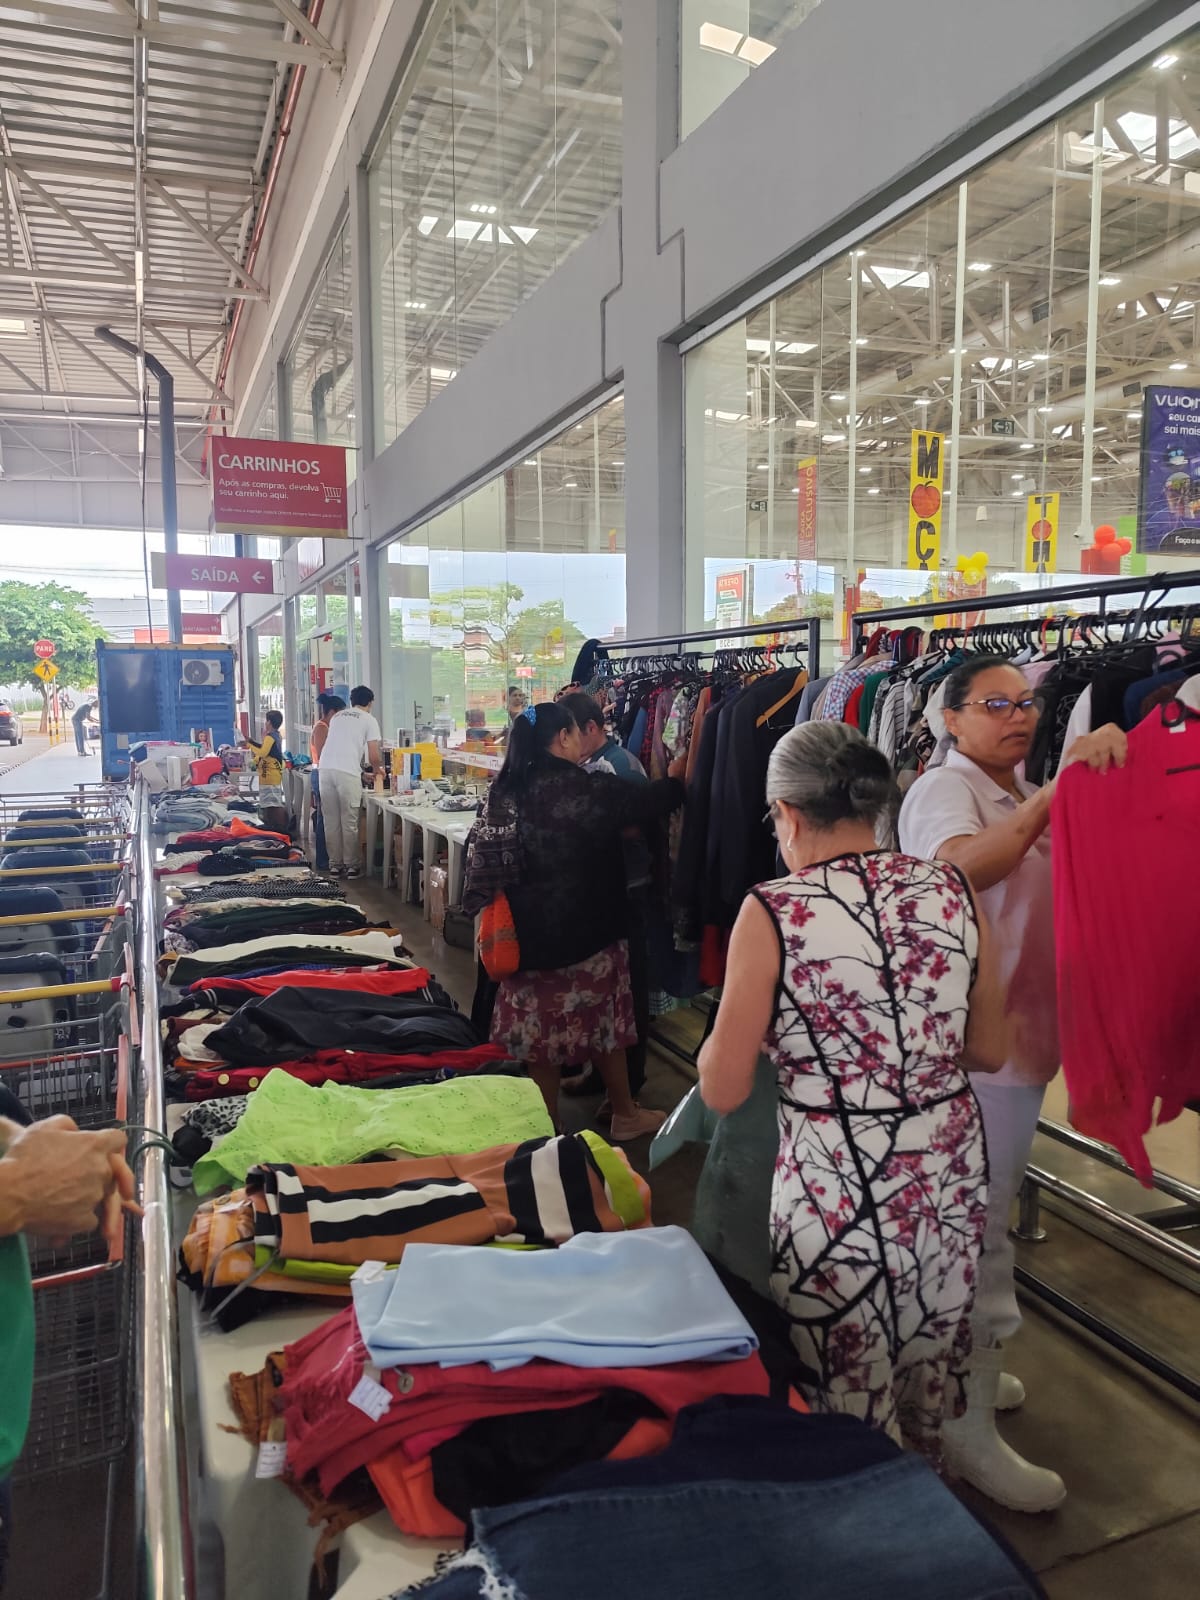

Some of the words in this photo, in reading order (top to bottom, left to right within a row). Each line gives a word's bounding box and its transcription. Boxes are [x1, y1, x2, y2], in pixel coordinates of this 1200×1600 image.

[1164, 423, 1179, 434] sai
[218, 454, 321, 475] CARRINHOS
[219, 477, 239, 488] Após
[289, 482, 320, 492] devolva
[235, 490, 268, 498] carrinho
[191, 566, 240, 583] SAÍDA
[36, 645, 53, 653] PARE
